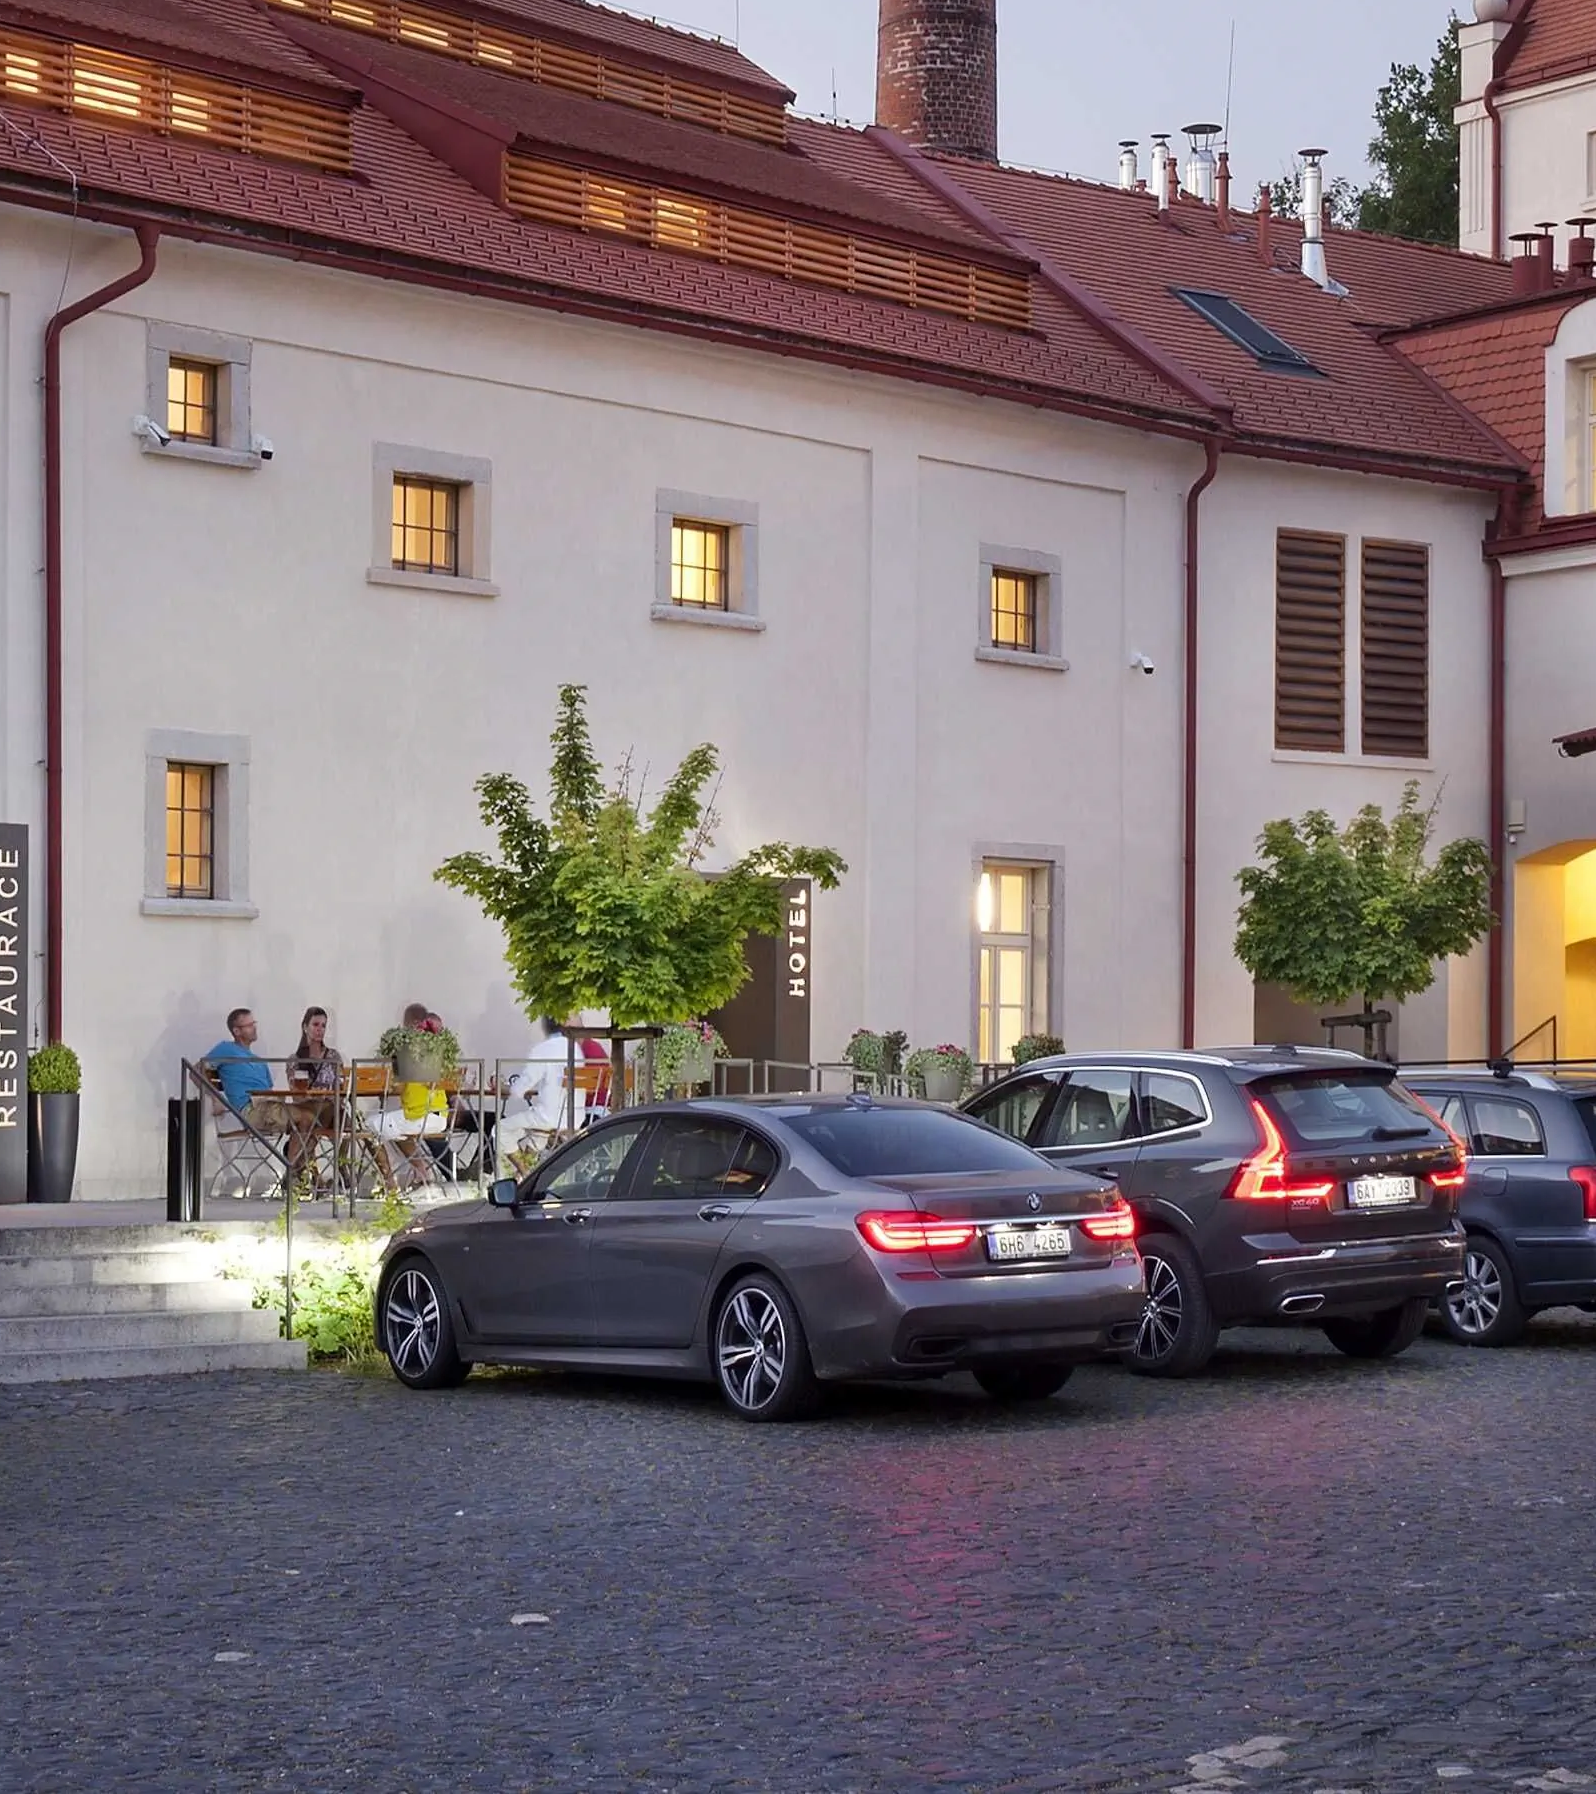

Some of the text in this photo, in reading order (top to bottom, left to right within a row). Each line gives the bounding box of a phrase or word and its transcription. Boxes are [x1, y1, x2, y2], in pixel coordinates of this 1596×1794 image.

[789, 889, 806, 997] HOTEL
[999, 1233, 1065, 1254] 6H6 4265
